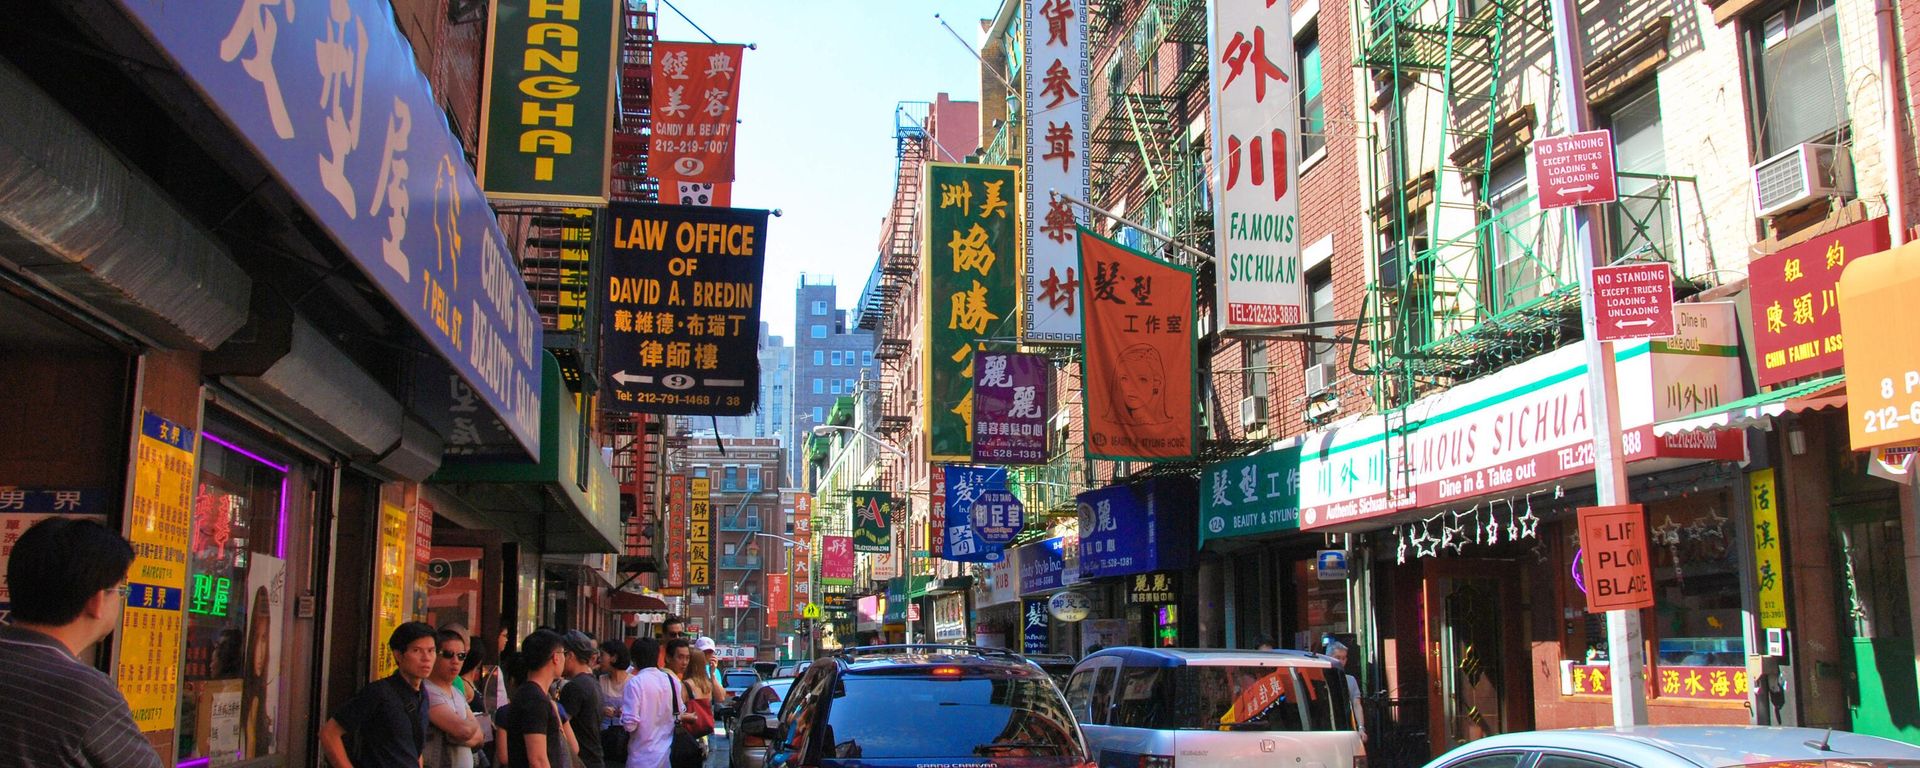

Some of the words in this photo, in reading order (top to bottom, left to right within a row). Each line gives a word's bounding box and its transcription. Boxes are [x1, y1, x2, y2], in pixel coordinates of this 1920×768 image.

[660, 85, 730, 118] 美容
[1220, 0, 1290, 201] 外川
[656, 122, 683, 136] CANDY
[687, 123, 696, 136] M.
[700, 123, 730, 136] BEAUTY
[655, 139, 729, 153] 212-219-7007
[1538, 144, 1553, 155] NO
[1557, 137, 1604, 153] STANDING
[1543, 156, 1571, 167] EXCEPT
[1574, 152, 1603, 163] TRUCKS
[1548, 164, 1587, 176] LOADING
[1591, 162, 1598, 171] &
[1550, 172, 1600, 186] UNLOADING
[614, 217, 669, 251] LAW
[675, 221, 754, 256] OFFICE
[1230, 212, 1294, 243] FAMOUS
[668, 257, 698, 276] OF
[1230, 253, 1297, 284] SICHUAN
[1784, 239, 1845, 282] 紐約
[1093, 261, 1153, 307] 髮型
[1597, 274, 1611, 285] NO
[1616, 270, 1665, 283] STANDING
[481, 226, 514, 334] CHUNG
[516, 294, 534, 371] WAH
[609, 276, 661, 305] DAVID
[668, 280, 686, 306] A.
[693, 281, 753, 309] BREDIN
[1601, 287, 1630, 297] EXCEPT
[1633, 284, 1663, 294] TRUCKS
[423, 268, 431, 311] 7
[431, 278, 450, 338] PELL
[451, 305, 462, 352] ST.
[1606, 297, 1646, 307] LOADING
[1651, 296, 1658, 304] &
[1608, 306, 1660, 318] UNLOADING
[1231, 303, 1299, 323] TEL:212-233-3888
[1681, 312, 1699, 328] Dine
[1700, 314, 1708, 328] in
[1124, 314, 1183, 334] 工作室
[1676, 324, 1682, 334] &
[1666, 337, 1684, 349] Take
[1685, 338, 1700, 351] out
[1765, 348, 1786, 369] CHIN
[1789, 339, 1820, 363] FAMILY
[470, 299, 514, 411] BEAUTY
[639, 340, 719, 370] 律師樓
[616, 390, 633, 401] Tel:
[637, 392, 710, 406] 212-791-1468
[726, 396, 740, 406] 38
[1667, 382, 1719, 412] 川外川
[1880, 378, 1894, 399] 8
[160, 421, 181, 444] 女界
[1317, 447, 1385, 498] 川外川
[1439, 480, 1462, 498] Dine
[1463, 476, 1474, 493] in
[1475, 474, 1485, 488] &
[1486, 466, 1513, 487] Take
[1515, 457, 1537, 479] out
[1233, 513, 1258, 529] BEAUTY
[1261, 514, 1267, 524] &
[1269, 508, 1299, 523] STYLING
[1326, 504, 1358, 521] Authentic
[1359, 496, 1387, 514] Sichuan
[1598, 550, 1642, 569] PLOW
[1597, 575, 1648, 597] BLADE
[143, 586, 167, 609] 男界
